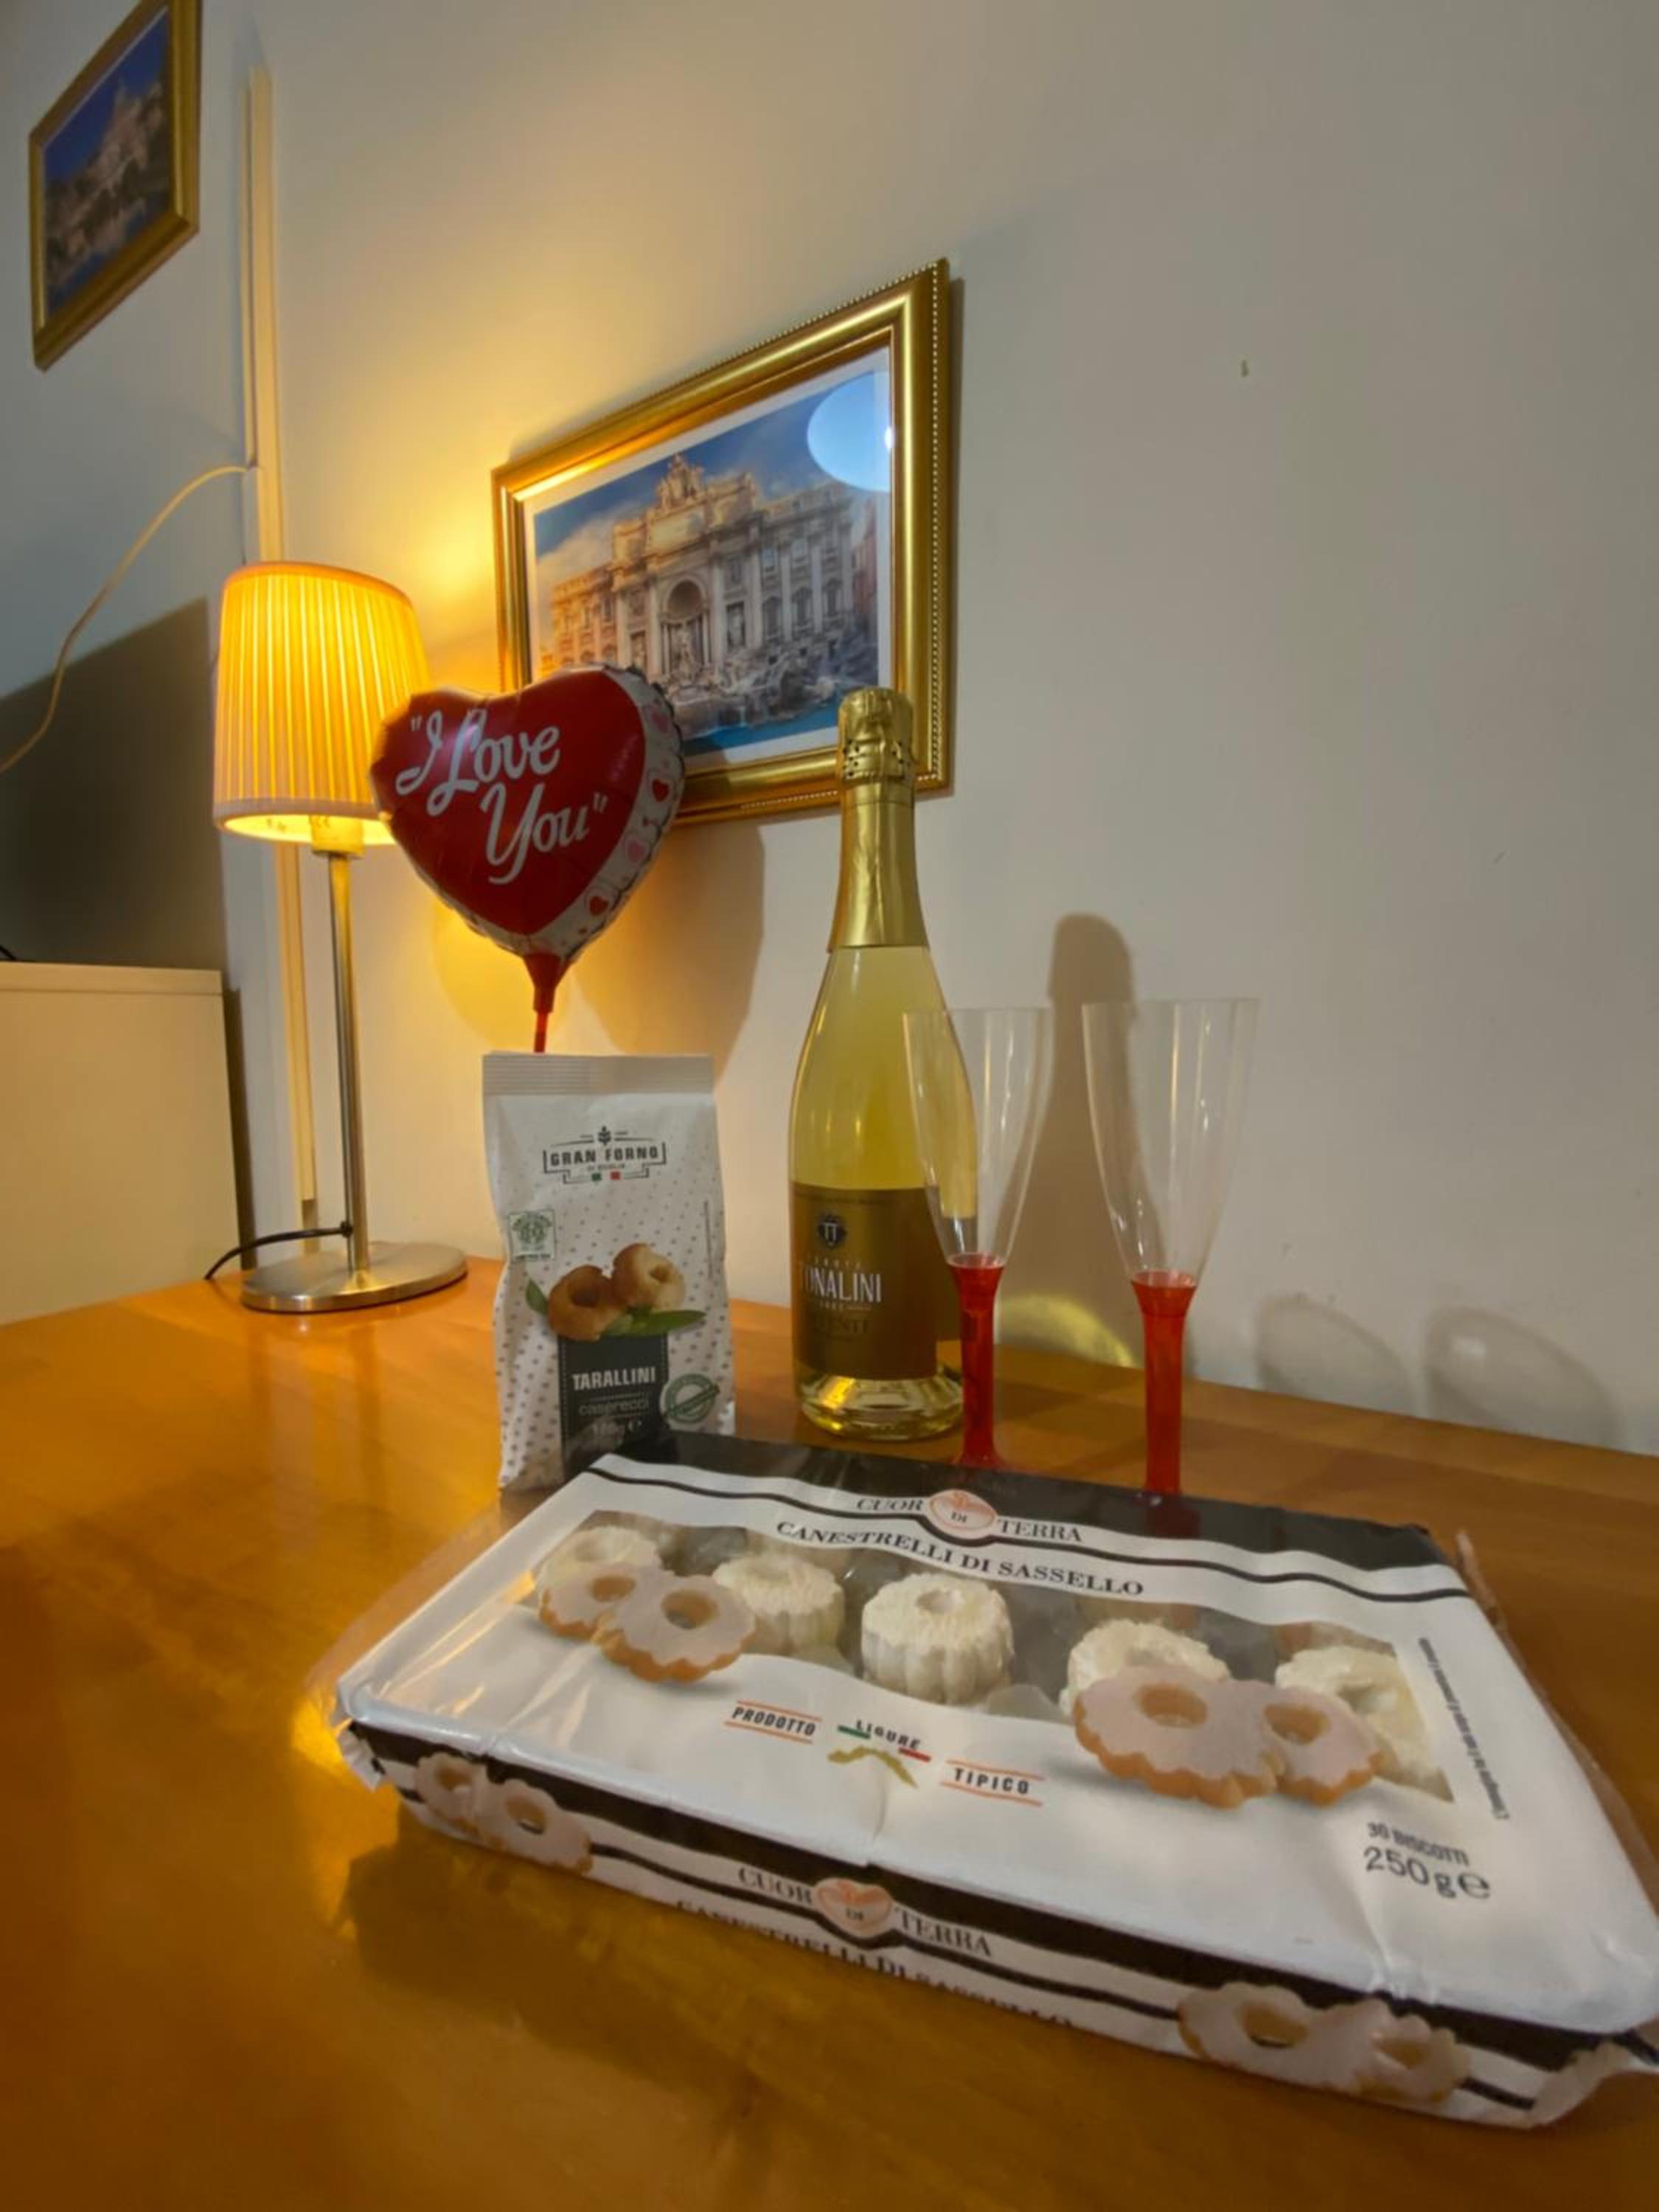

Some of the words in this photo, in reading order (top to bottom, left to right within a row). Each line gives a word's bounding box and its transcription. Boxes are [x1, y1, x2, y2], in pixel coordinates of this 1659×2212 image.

[550, 1150, 596, 1166] GRAN
[605, 1146, 658, 1161] FORNO
[572, 1366, 656, 1391] TARALLINI
[856, 1498, 923, 1512] CUOR
[950, 1511, 967, 1523] DI
[997, 1517, 1082, 1543] TERRA
[777, 1520, 953, 1563] CANESTRELLI
[961, 1554, 991, 1573] DI
[998, 1562, 1144, 1596] SASSELLO
[731, 1705, 816, 1736] PRODOTTO
[855, 1719, 922, 1750] LIGURE
[954, 1767, 1030, 1795] TIPICO
[738, 1865, 812, 1904] CUOR
[894, 1905, 992, 1957] TERRA
